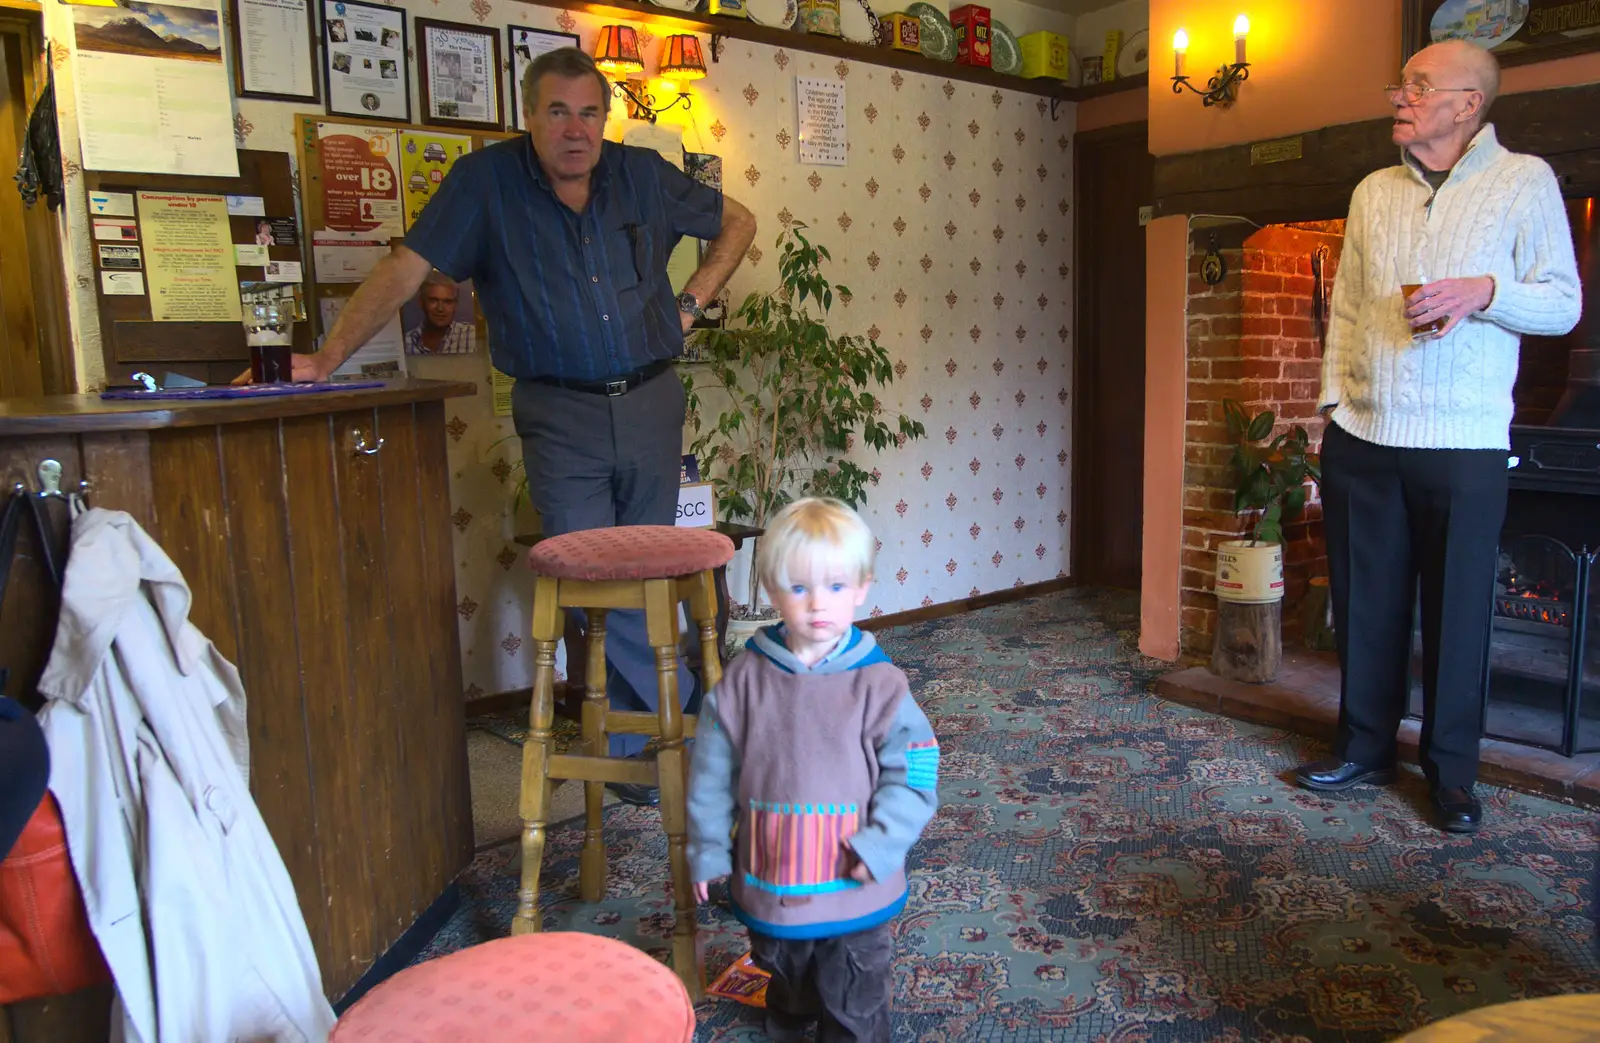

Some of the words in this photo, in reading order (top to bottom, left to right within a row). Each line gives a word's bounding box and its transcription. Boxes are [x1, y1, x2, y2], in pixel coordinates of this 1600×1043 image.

[1529, 0, 1600, 35] SUFFOLK
[434, 32, 449, 47] 30
[976, 25, 987, 39] RITZ
[372, 137, 387, 152] 21
[361, 167, 392, 191] 18
[431, 172, 442, 180] OR
